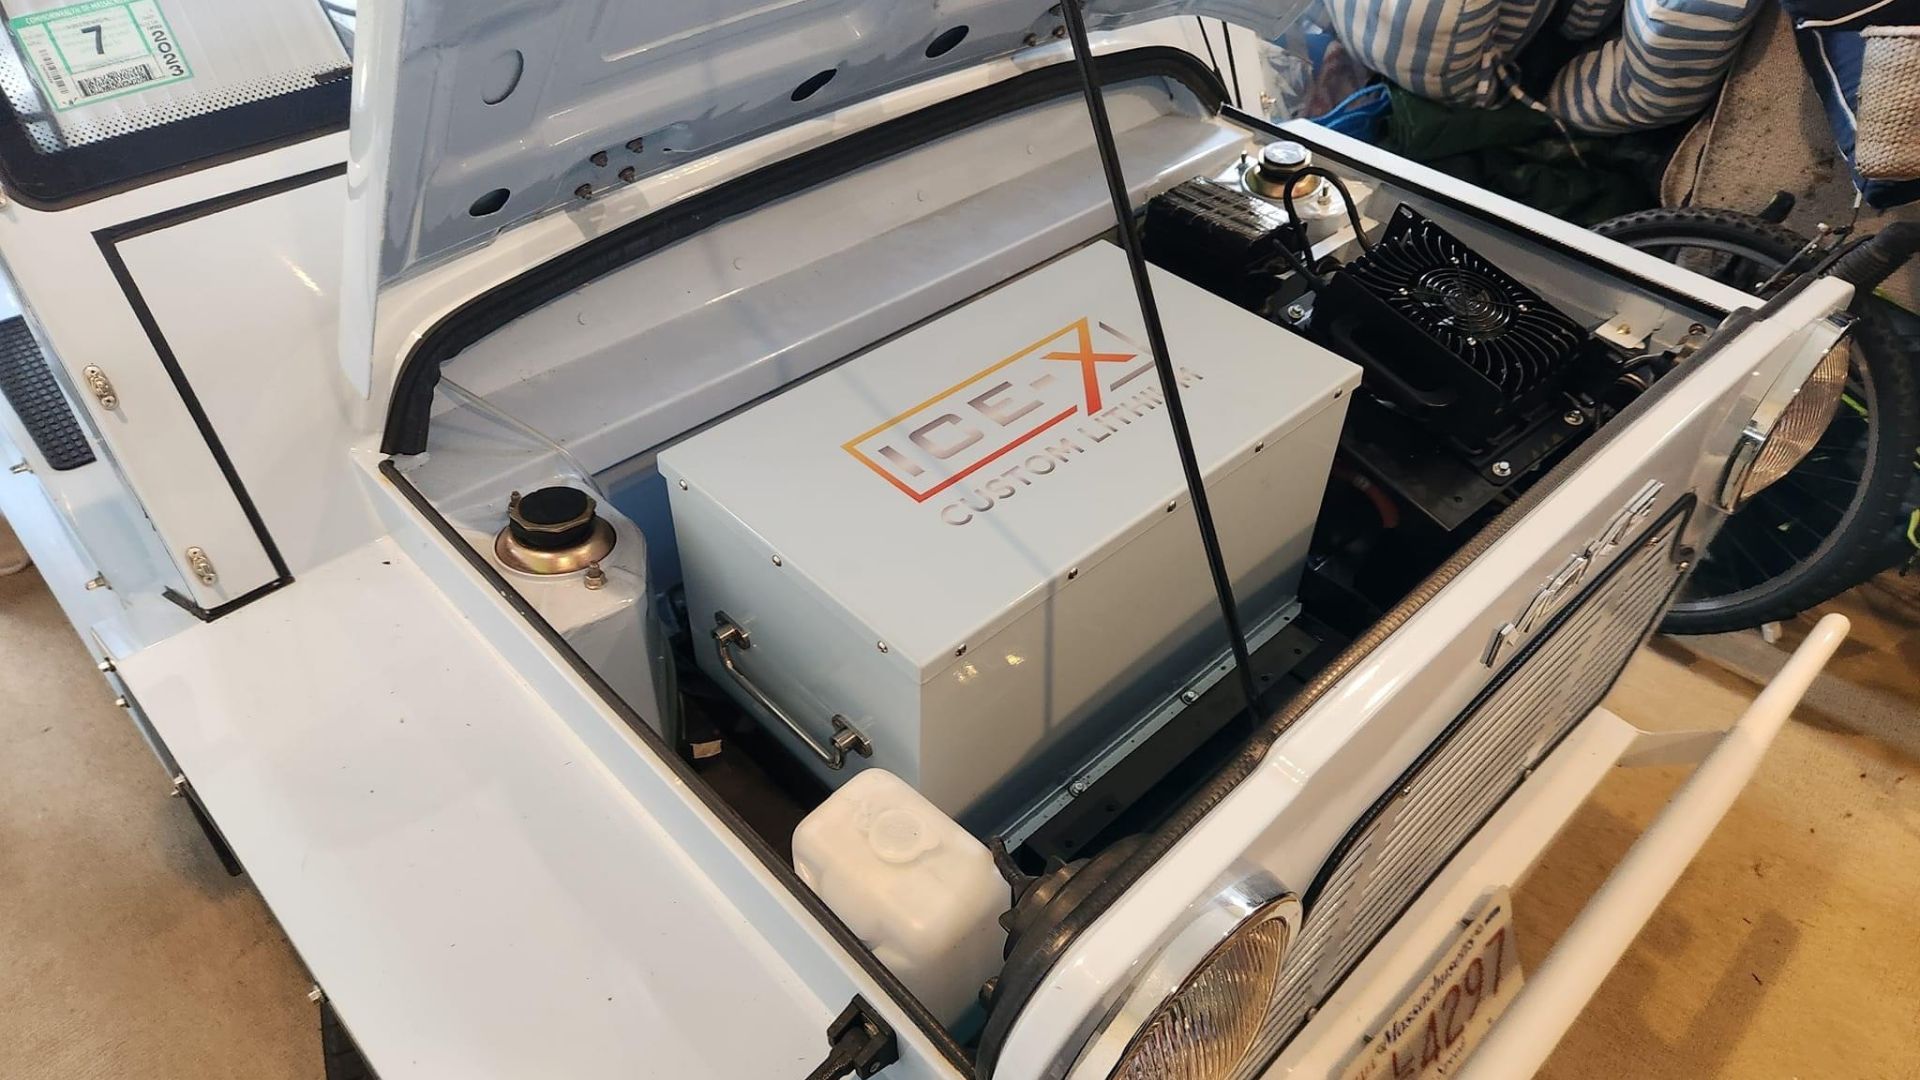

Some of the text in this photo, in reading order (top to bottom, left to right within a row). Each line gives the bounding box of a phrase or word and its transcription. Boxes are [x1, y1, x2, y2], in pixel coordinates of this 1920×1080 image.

[81, 24, 105, 55] 7
[152, 30, 185, 77] 2023
[940, 365, 1204, 526] CUSTOM LITHIM
